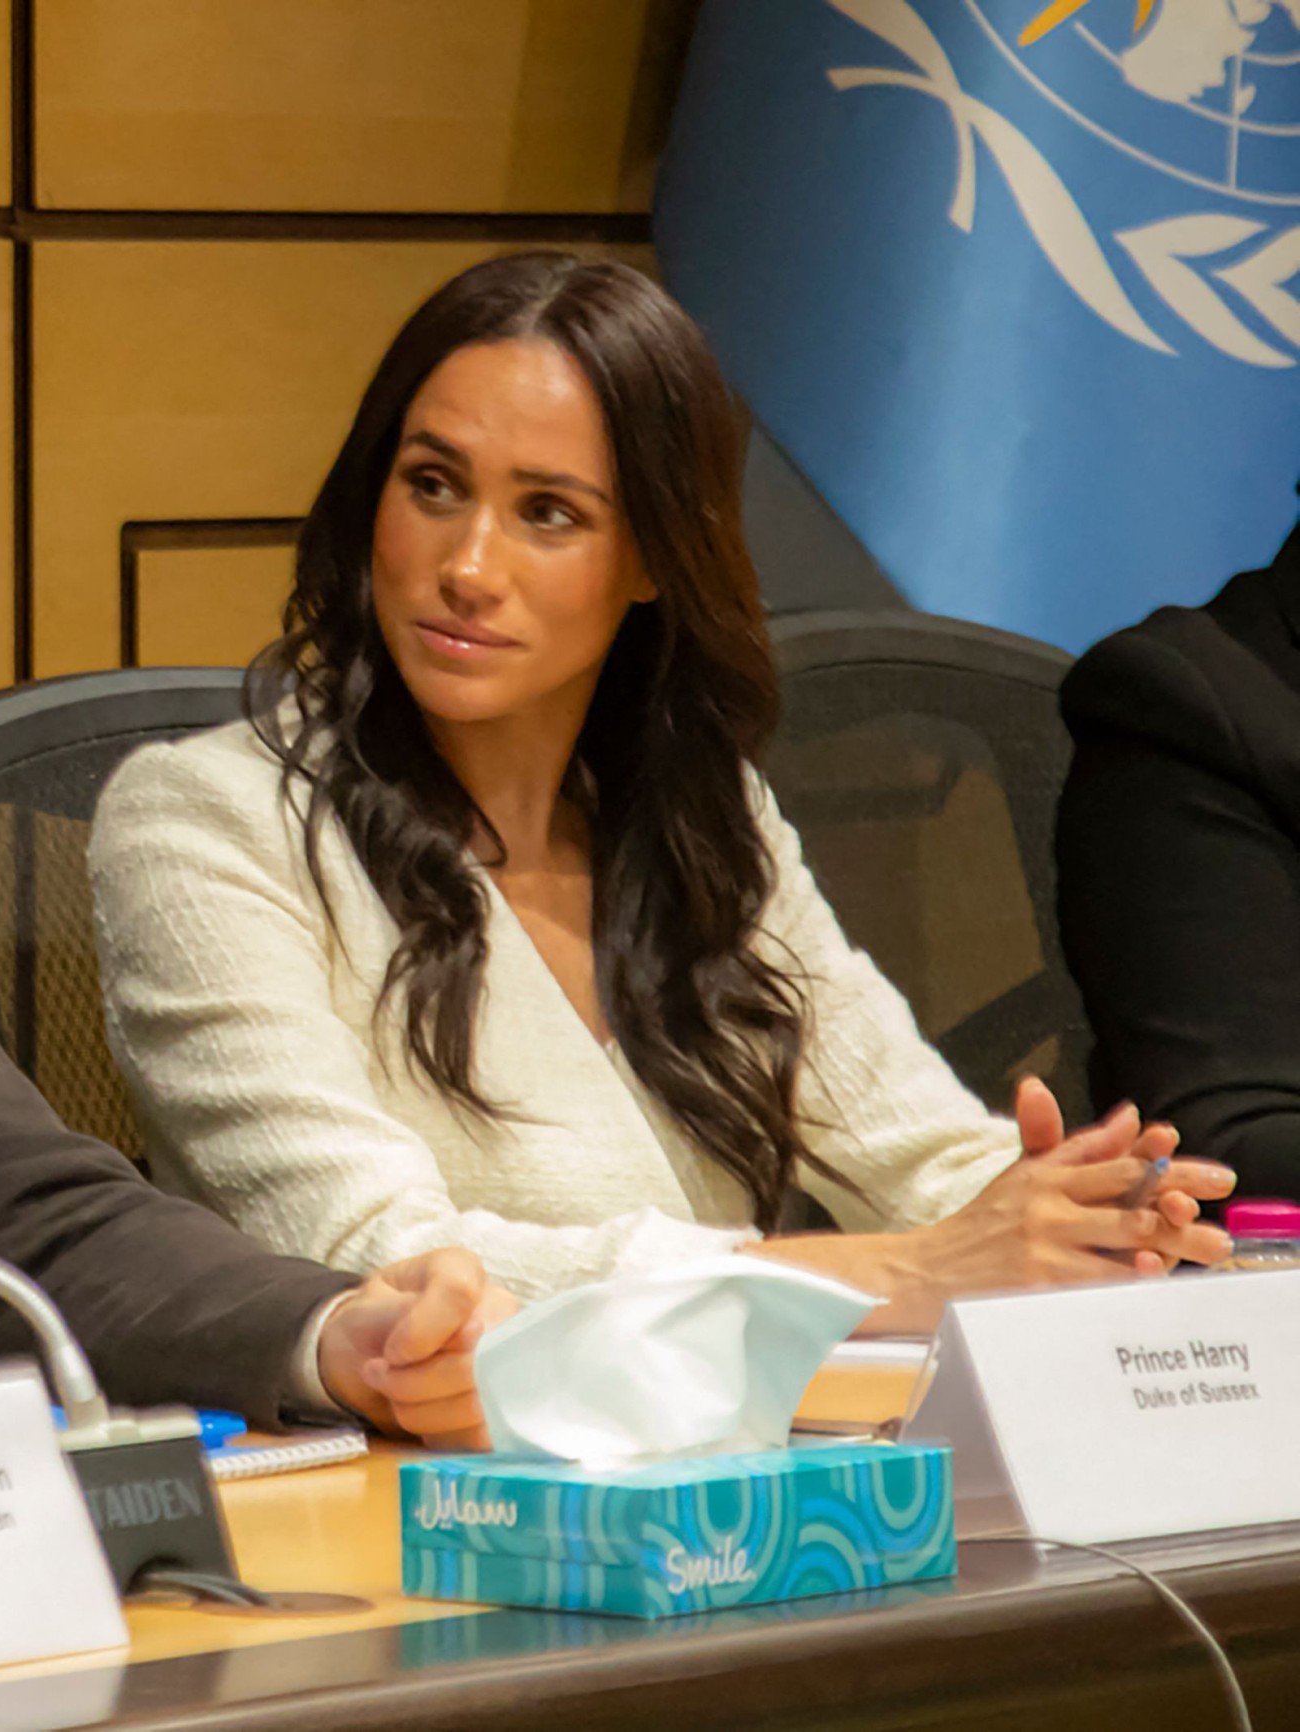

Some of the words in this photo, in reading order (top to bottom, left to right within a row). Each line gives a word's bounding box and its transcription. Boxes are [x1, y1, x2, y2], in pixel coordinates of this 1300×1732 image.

[1115, 1346, 1187, 1375] Prince
[1188, 1340, 1251, 1372] Harry
[1133, 1386, 1177, 1410] Duke
[1180, 1383, 1197, 1406] of
[1198, 1382, 1260, 1404] Sussex
[666, 1535, 758, 1595] Smile
